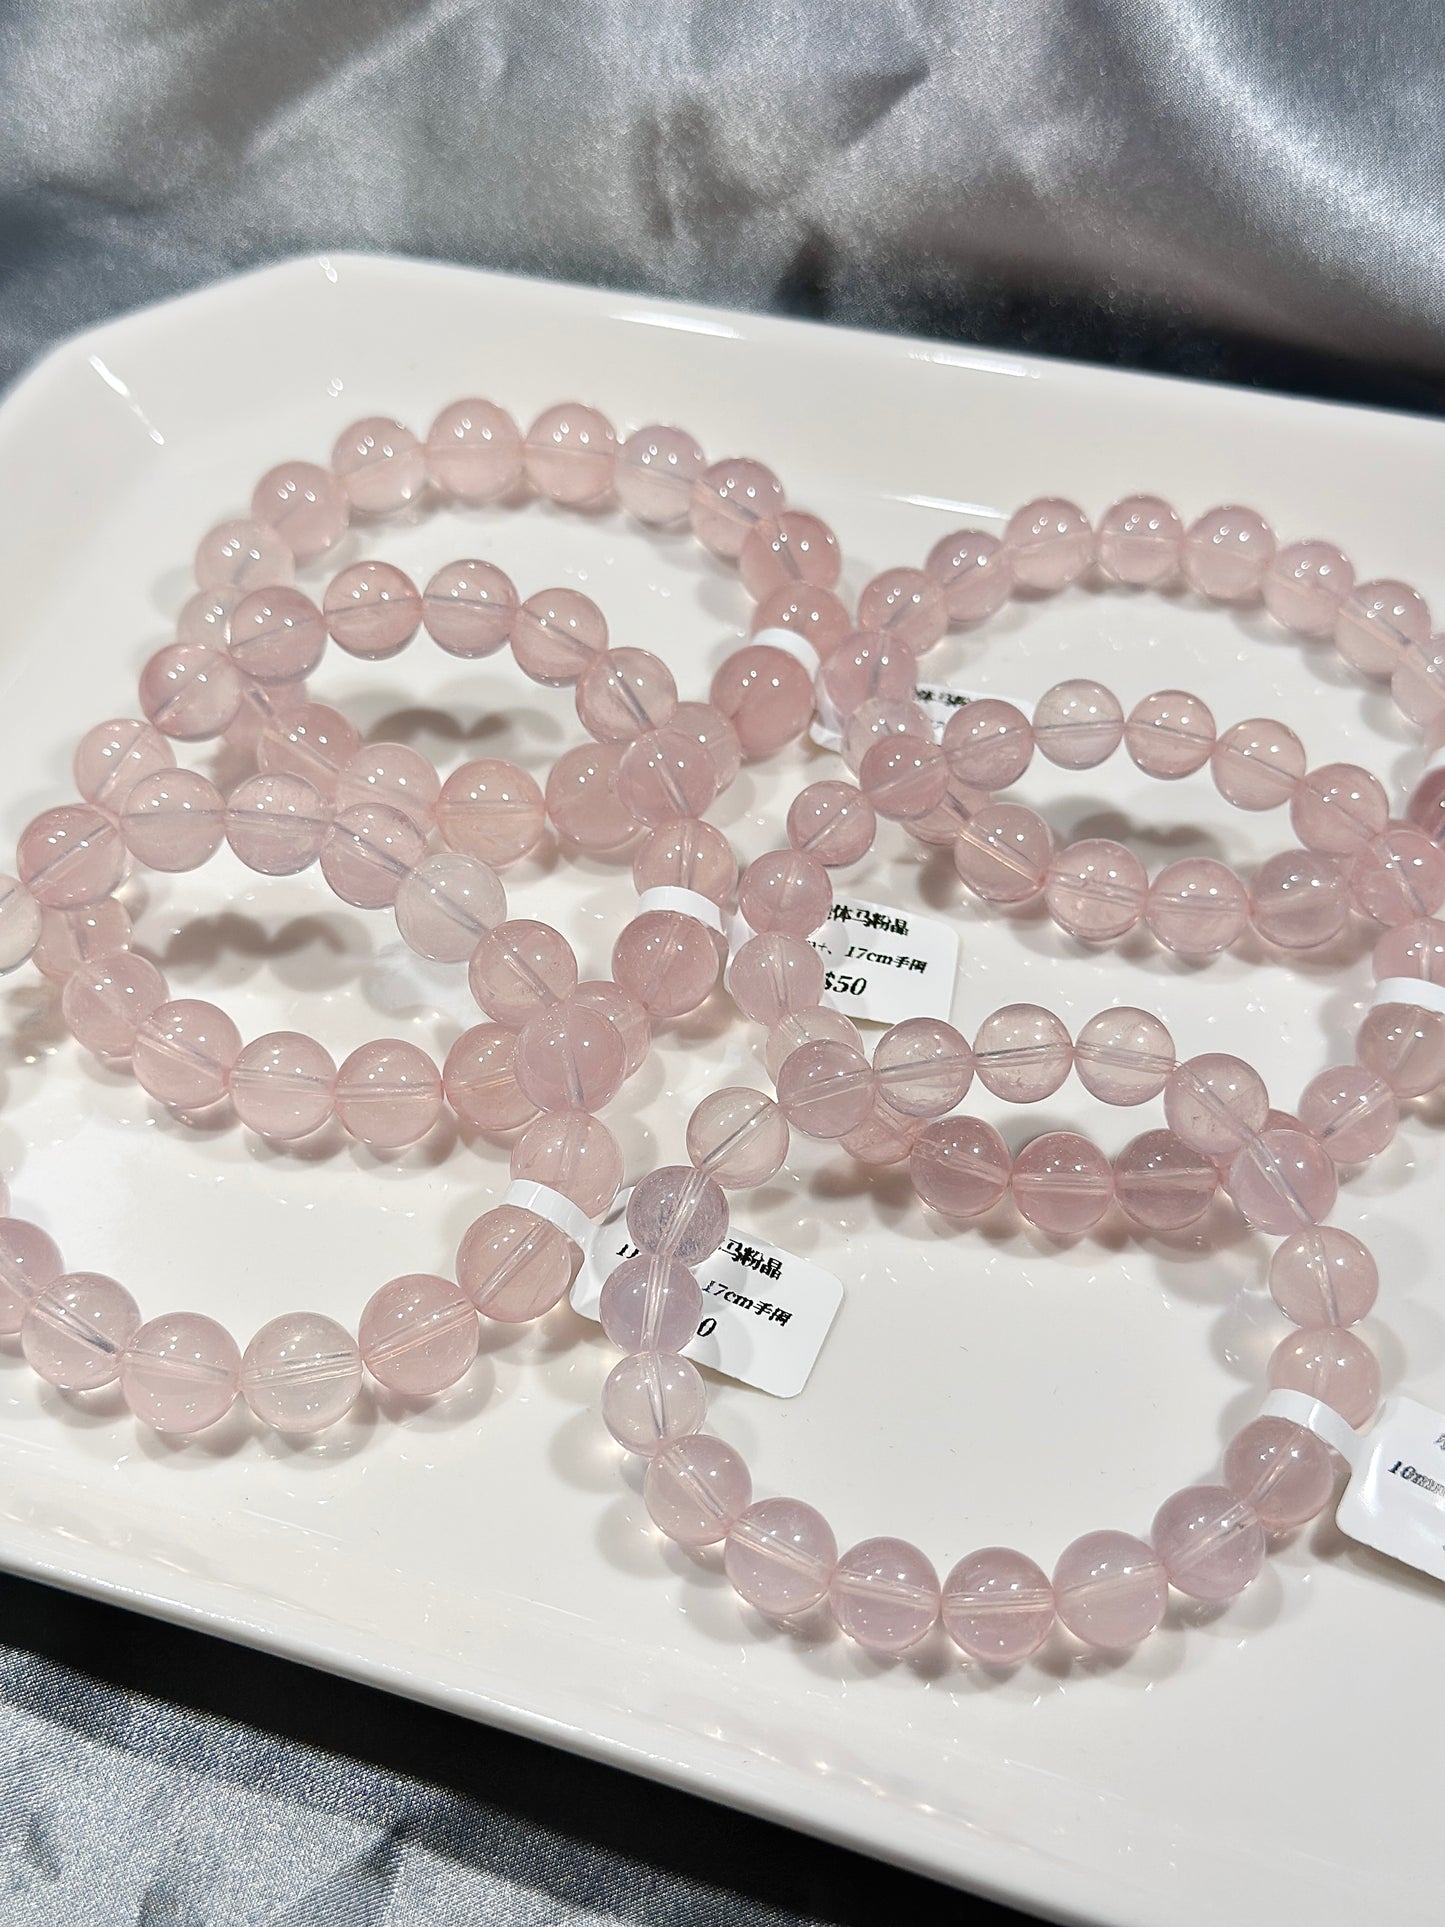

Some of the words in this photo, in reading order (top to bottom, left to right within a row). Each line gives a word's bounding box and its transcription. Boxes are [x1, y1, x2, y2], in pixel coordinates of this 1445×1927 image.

[828, 904, 909, 936] 体马粉晶
[718, 1238, 783, 1280] 马粉晶
